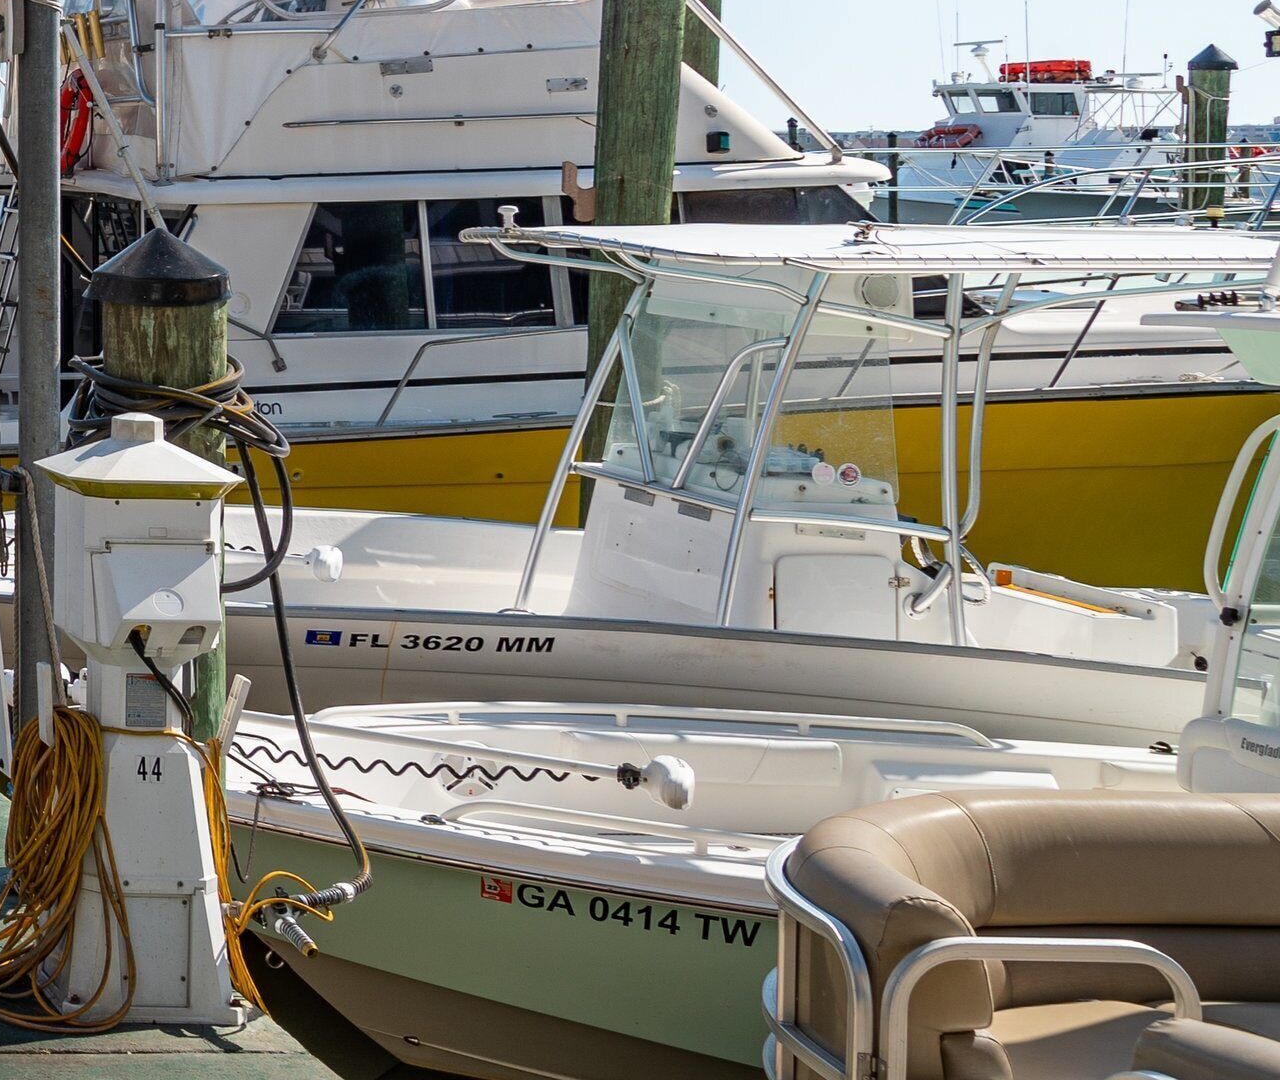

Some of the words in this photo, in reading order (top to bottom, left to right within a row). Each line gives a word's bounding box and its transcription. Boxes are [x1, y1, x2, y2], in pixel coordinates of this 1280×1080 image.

[254, 400, 283, 415] ton
[349, 633, 390, 648] FL
[401, 634, 485, 652] 3620
[496, 637, 556, 653] MM
[137, 756, 162, 782] 44
[516, 883, 576, 916] GA
[589, 896, 680, 936] 0414
[694, 912, 761, 947] TW
